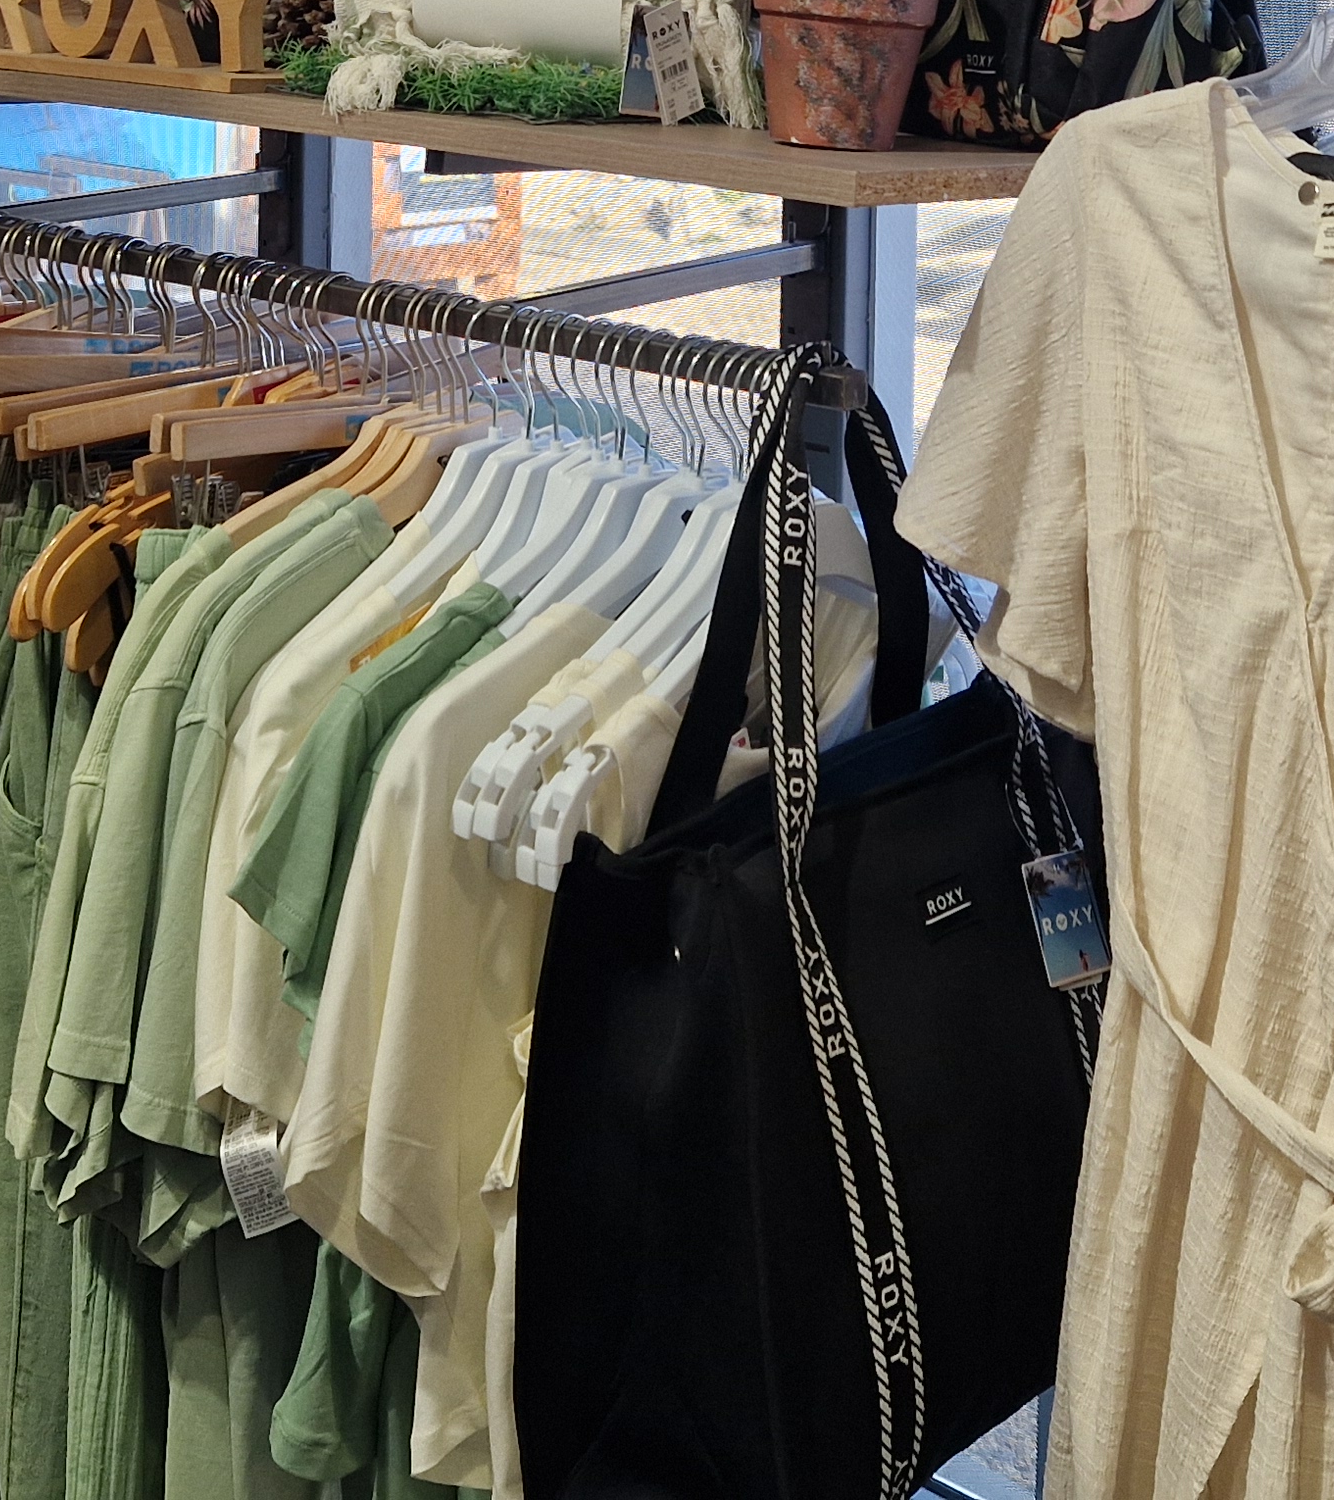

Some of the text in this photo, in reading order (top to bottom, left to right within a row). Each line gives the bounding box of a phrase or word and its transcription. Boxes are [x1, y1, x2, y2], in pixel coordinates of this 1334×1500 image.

[631, 53, 653, 71] RO
[652, 19, 681, 41] ROXY
[784, 462, 808, 566] ROXY
[786, 747, 806, 857] ROXY
[926, 887, 965, 916] ROXY
[1041, 904, 1093, 937] ROXY
[805, 946, 847, 1058] ROXY
[873, 1251, 909, 1366] ROXY
